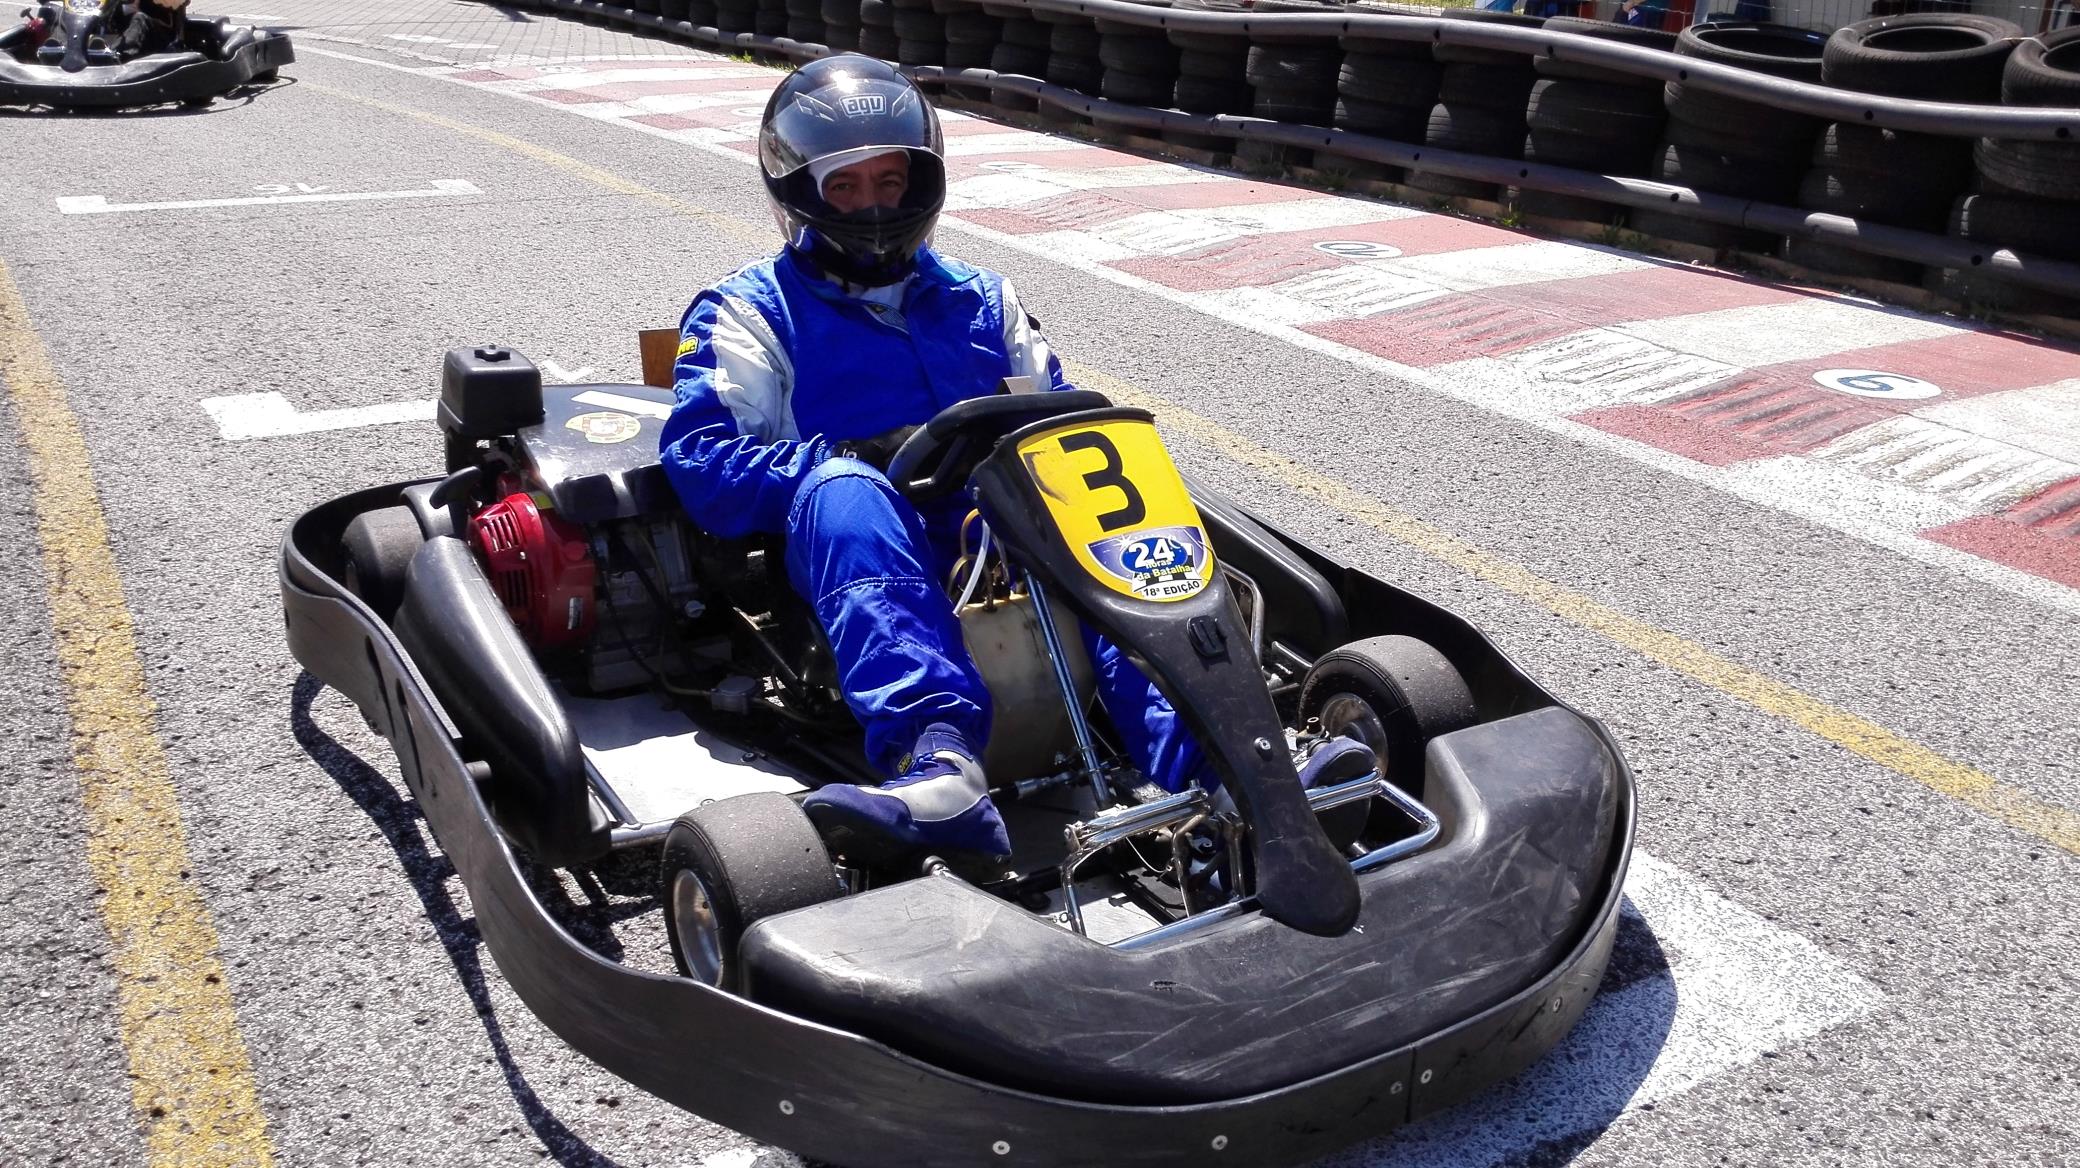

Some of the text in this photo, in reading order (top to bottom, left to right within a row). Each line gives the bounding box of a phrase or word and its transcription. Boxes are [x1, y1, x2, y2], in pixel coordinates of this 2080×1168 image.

[847, 98, 881, 113] agv
[1058, 431, 1146, 532] 3
[1128, 539, 1175, 569] 24
[1137, 564, 1193, 581] da Batalha
[1164, 580, 1200, 595] EDIÇÃO
